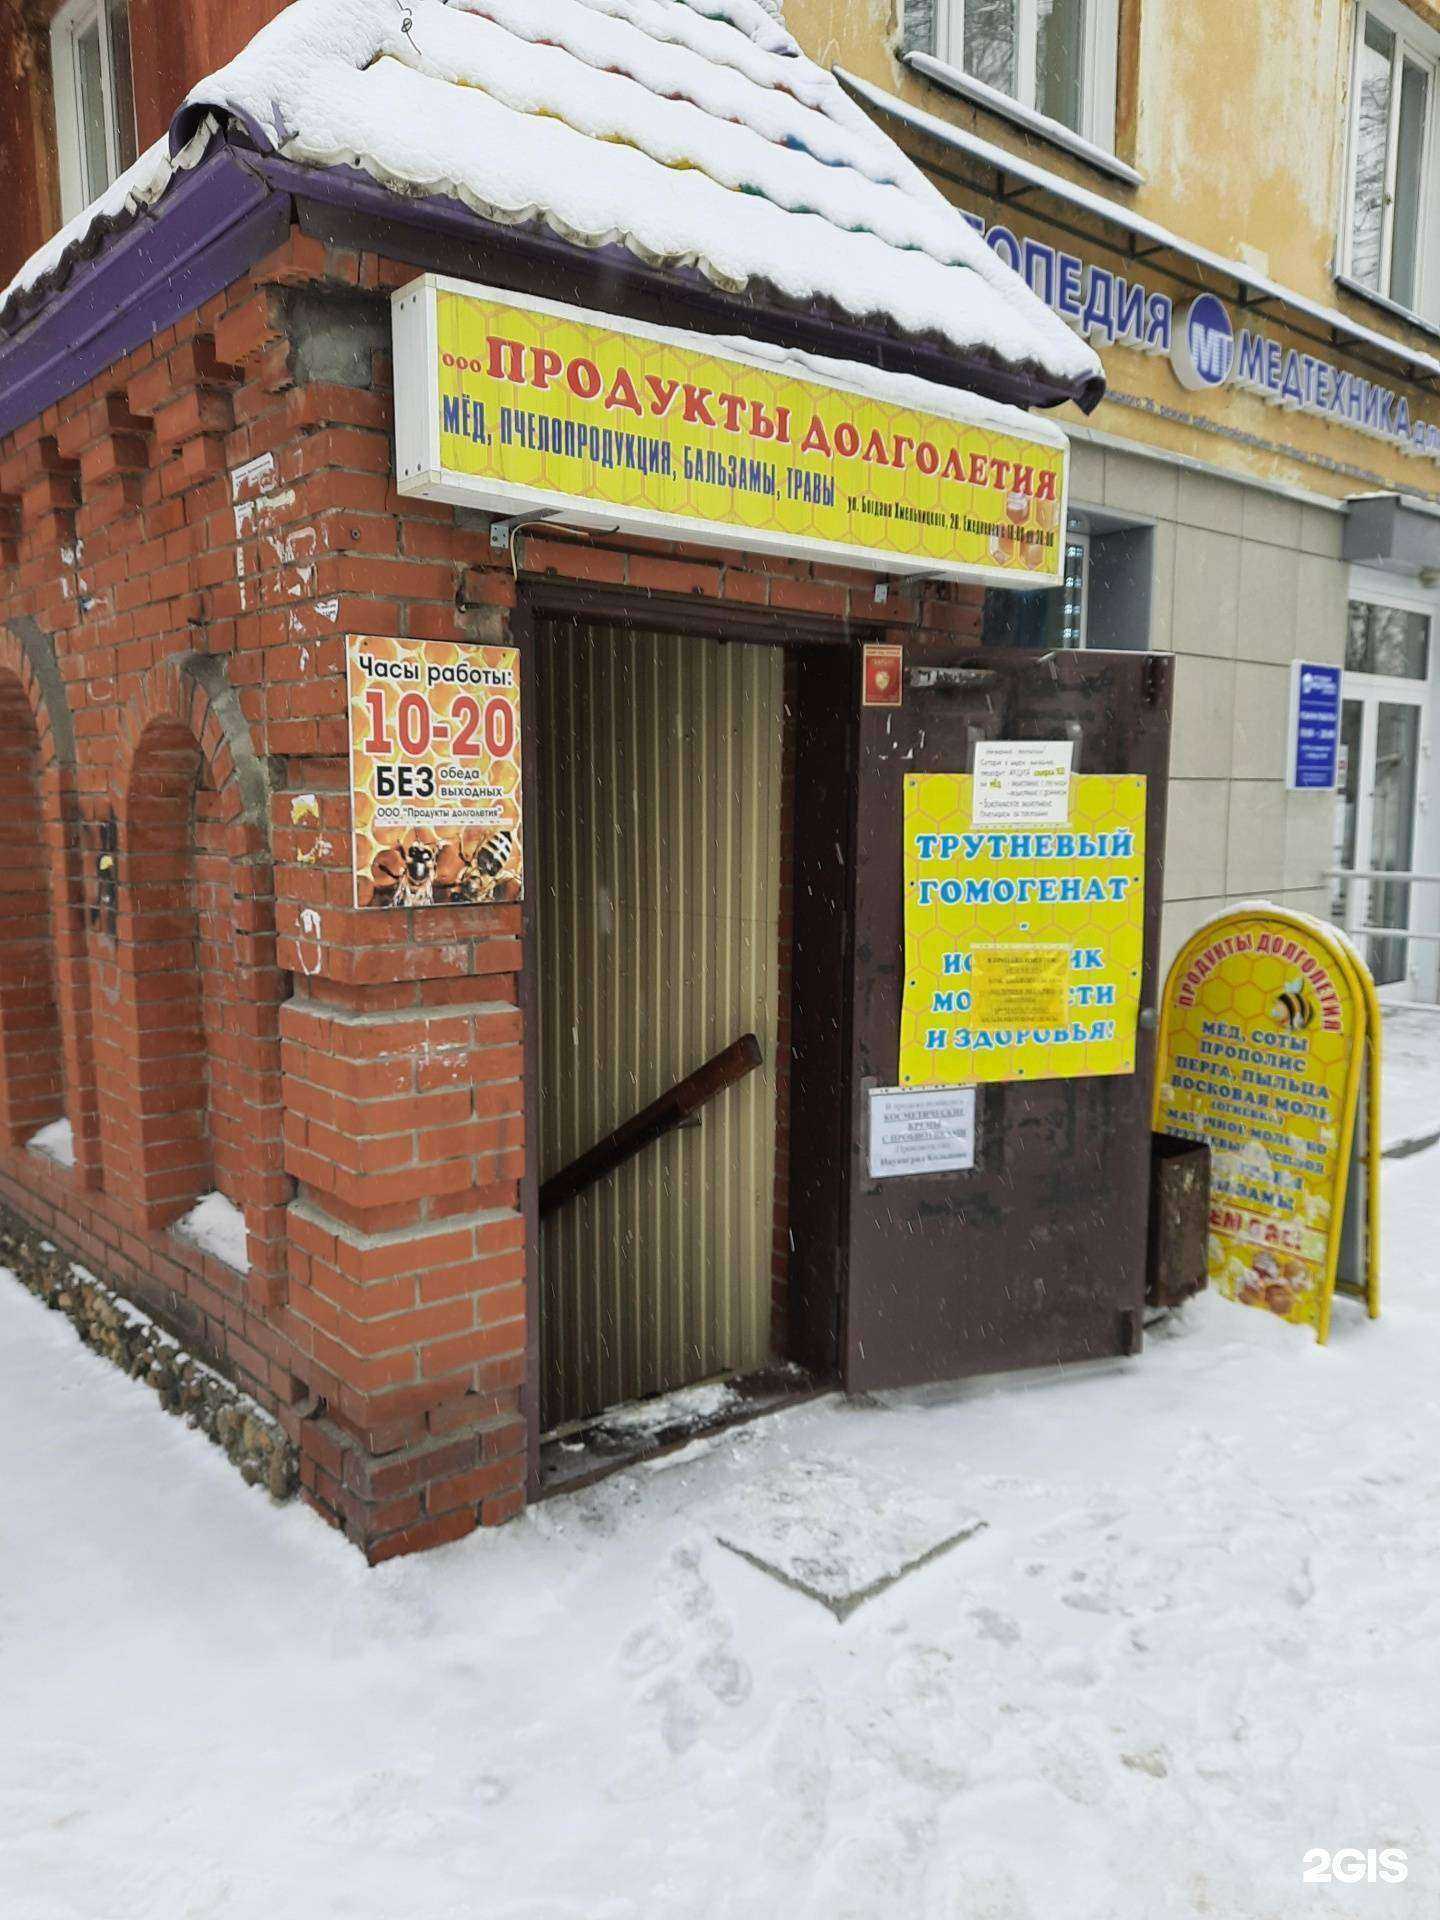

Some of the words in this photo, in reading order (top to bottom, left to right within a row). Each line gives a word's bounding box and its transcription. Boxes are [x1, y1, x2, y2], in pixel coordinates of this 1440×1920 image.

[959, 210, 1172, 351] ОПЕДИЯ
[1238, 328, 1412, 439] МЕДТЕХНИКА
[443, 393, 493, 446] МЁД,
[501, 406, 677, 481] ПЧЕЛОПРОДУКЦИЯ,
[684, 445, 781, 500] БАЛЬЗАМЫ,
[787, 467, 835, 507] ТРАВЫ
[801, 414, 1058, 500] ДОЛГОЛЕТИЯ
[359, 655, 419, 680] Часы
[427, 663, 513, 686] работы:
[364, 690, 514, 758] 10-20
[376, 765, 434, 797] БЕЗ
[440, 767, 480, 780] обеда
[440, 787, 503, 798] выходных
[377, 807, 400, 818] ООО
[915, 828, 1134, 859] ТРУТНЕВЫЙ
[918, 877, 1129, 904] ГОМОГЕНАТ
[1177, 933, 1254, 1009] ПРОДУКТЫ
[1256, 932, 1343, 1032] ДОЛГОЛЕТИЯ
[925, 1029, 948, 1050] И
[953, 1020, 1115, 1050] ЗДОРОВЬЯ!
[1251, 1029, 1308, 1051] СОТЫ
[1200, 1040, 1307, 1073] ПРОПОЛИС
[1171, 1074, 1270, 1108] ВОСКОВАЯ
[1175, 1055, 1237, 1081] ПЕРГА,
[1241, 1068, 1330, 1100] ПЫЛЬЦА
